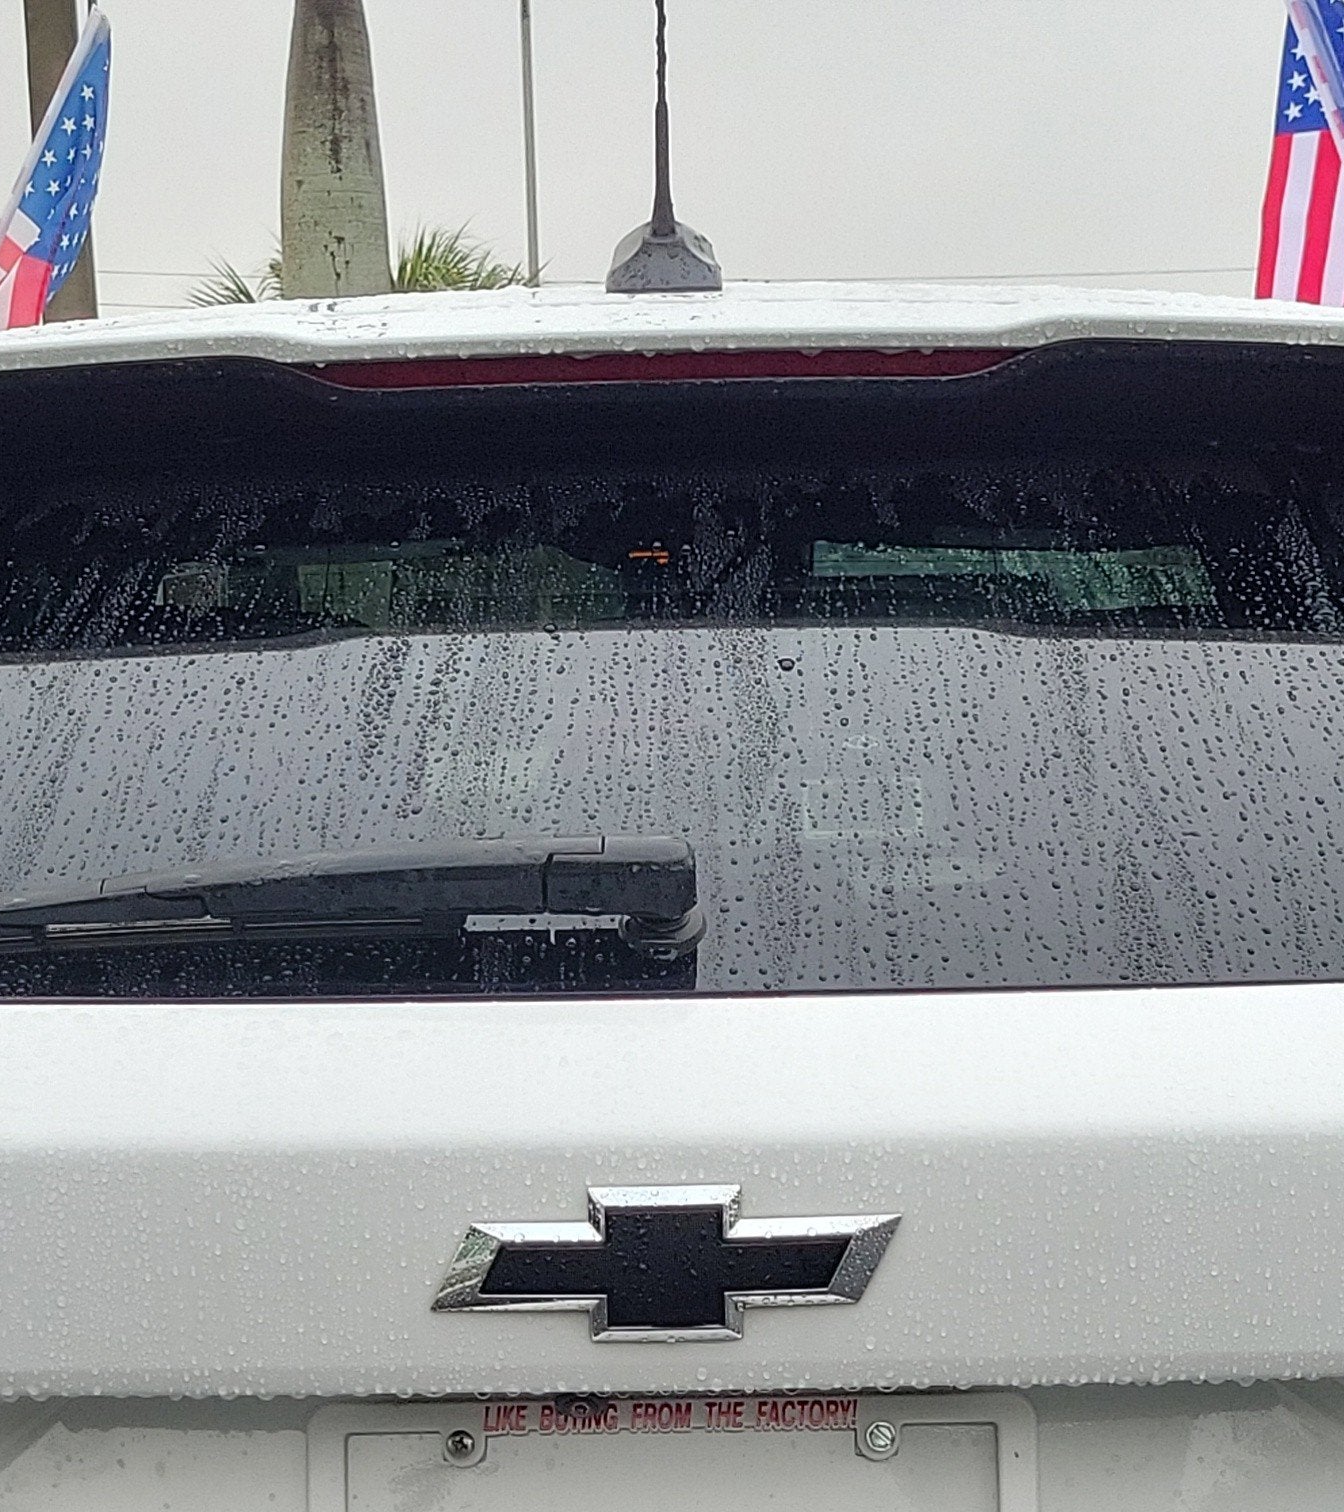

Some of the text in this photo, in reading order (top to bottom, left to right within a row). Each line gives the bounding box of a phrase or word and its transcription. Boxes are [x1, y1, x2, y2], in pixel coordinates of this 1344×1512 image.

[482, 1404, 528, 1432] LIKE
[630, 1402, 692, 1429] FROM
[705, 1401, 745, 1427] THE
[757, 1399, 858, 1426] FACTORY!
